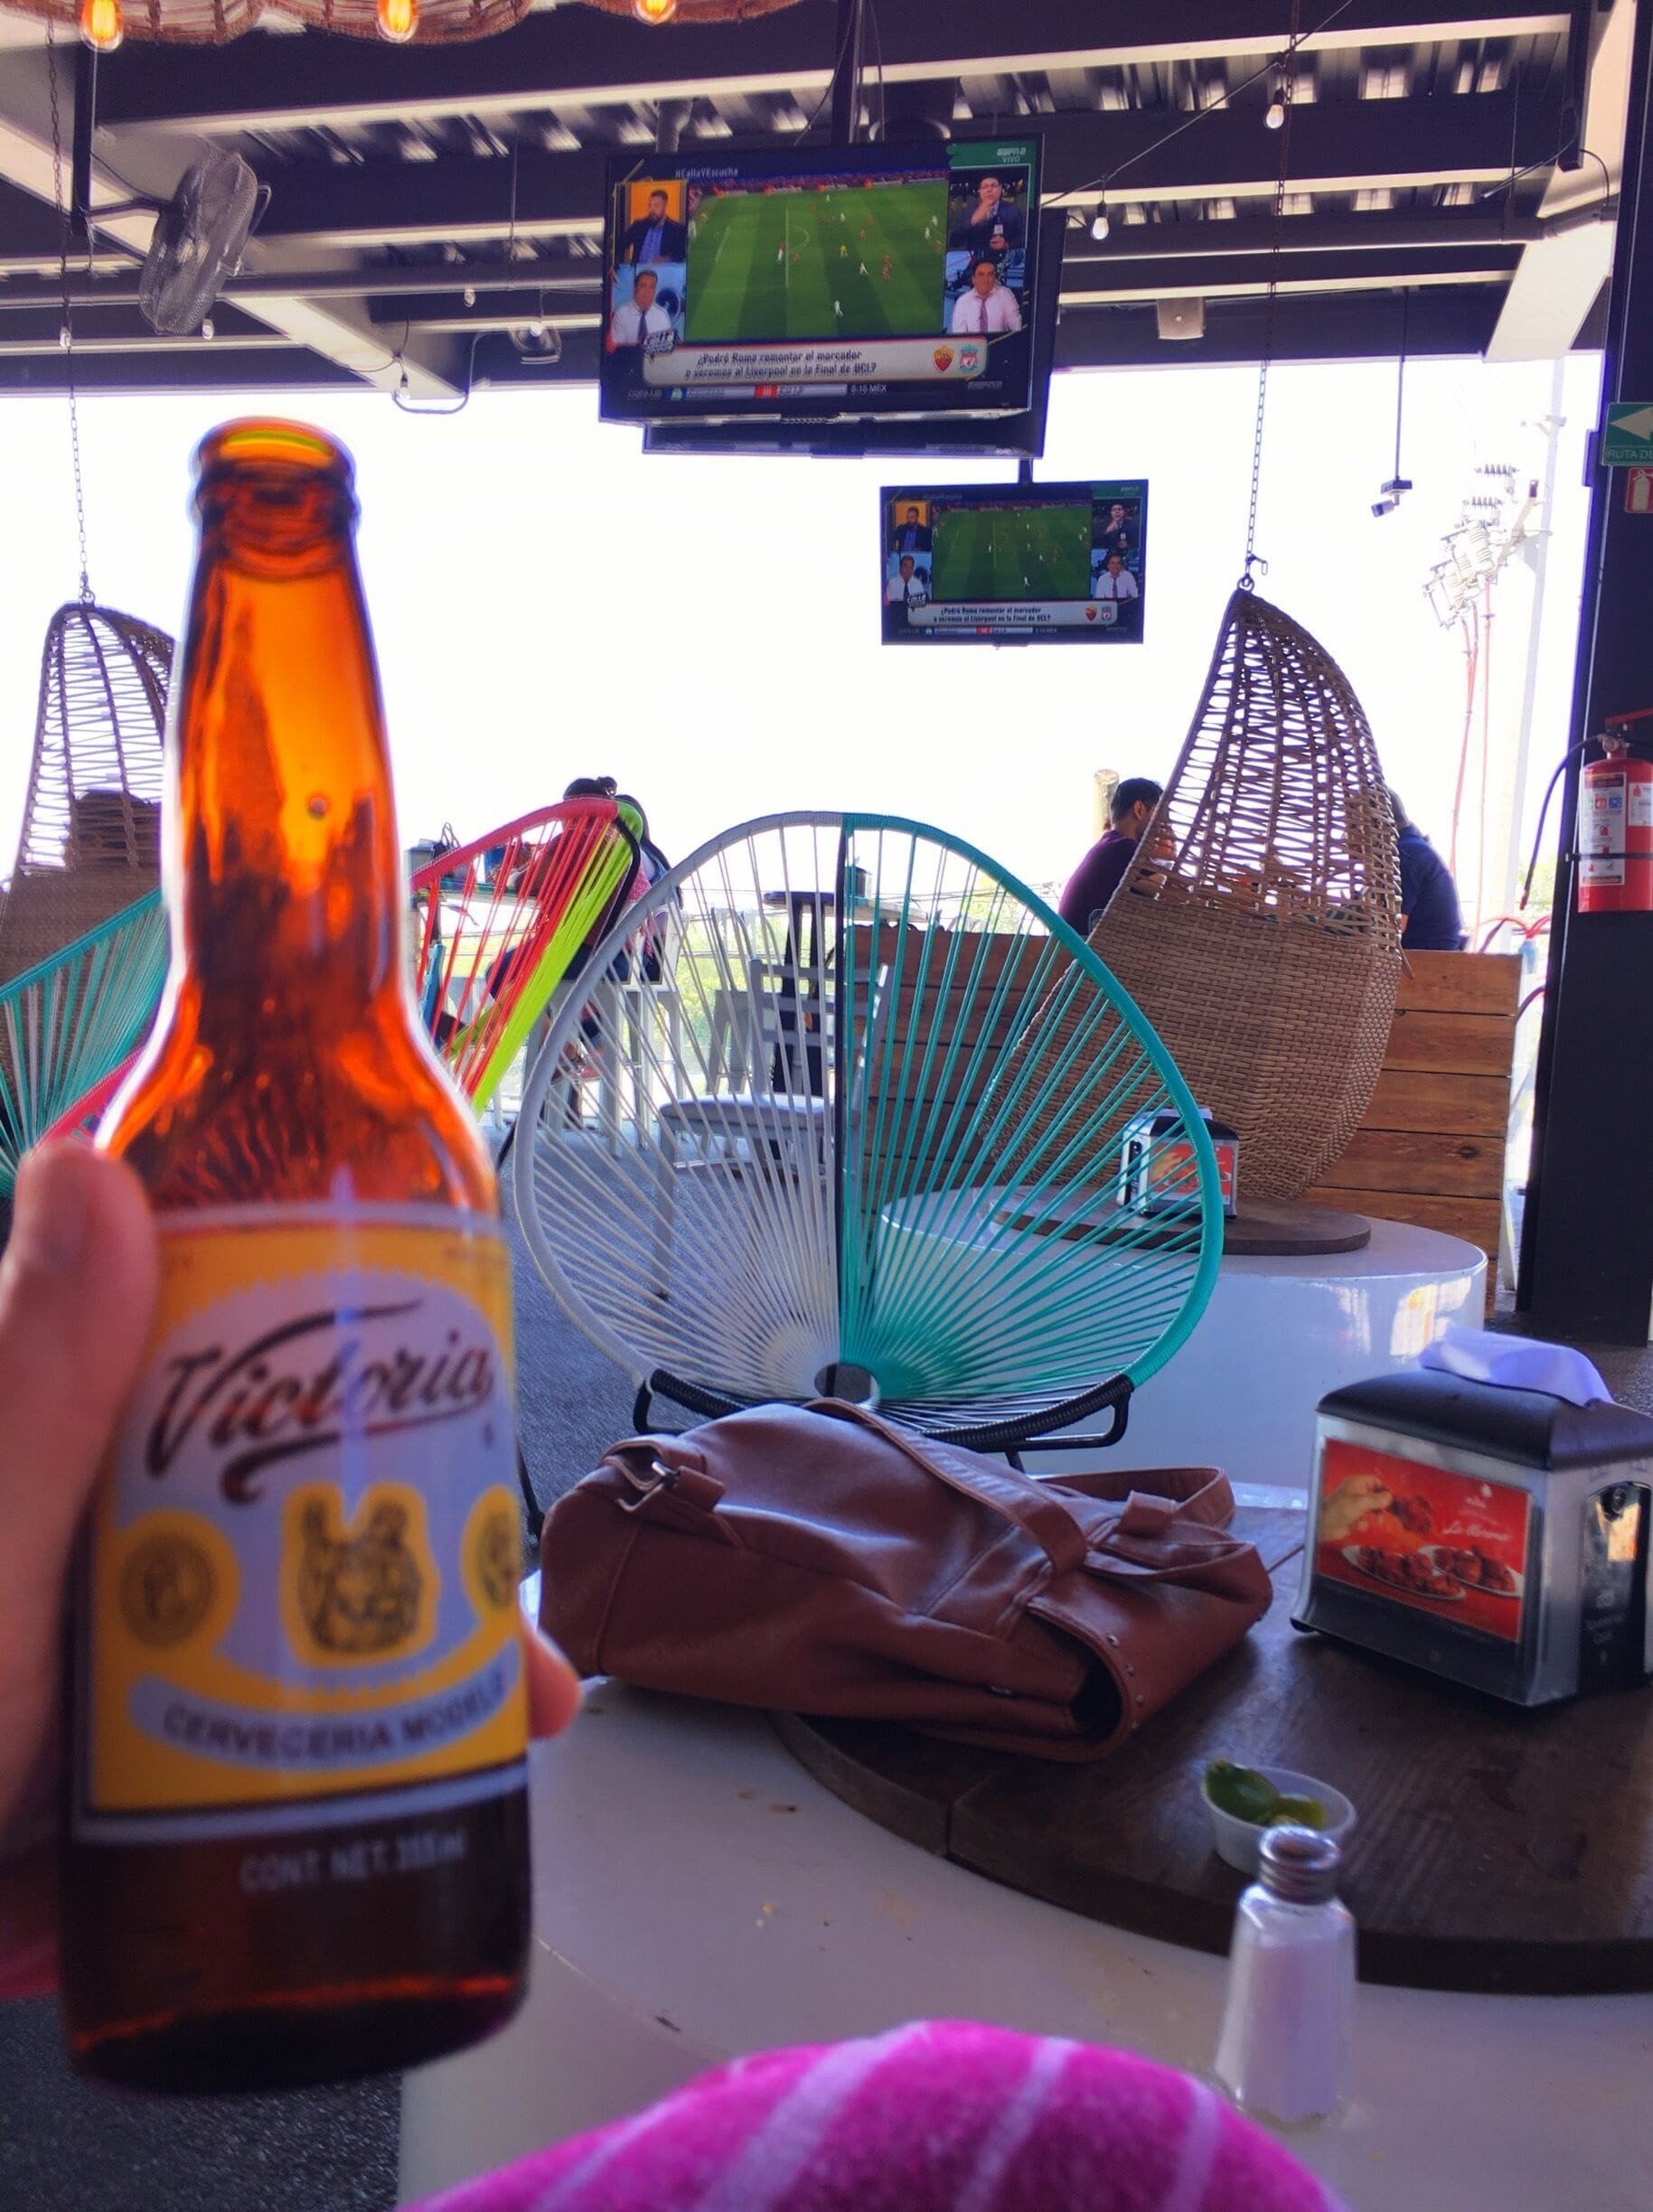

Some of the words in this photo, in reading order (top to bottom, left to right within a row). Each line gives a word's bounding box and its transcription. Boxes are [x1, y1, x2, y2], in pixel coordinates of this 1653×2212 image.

[816, 349, 862, 362] marcador
[1608, 448, 1639, 460] RUTA
[146, 1298, 494, 1506] Victoria
